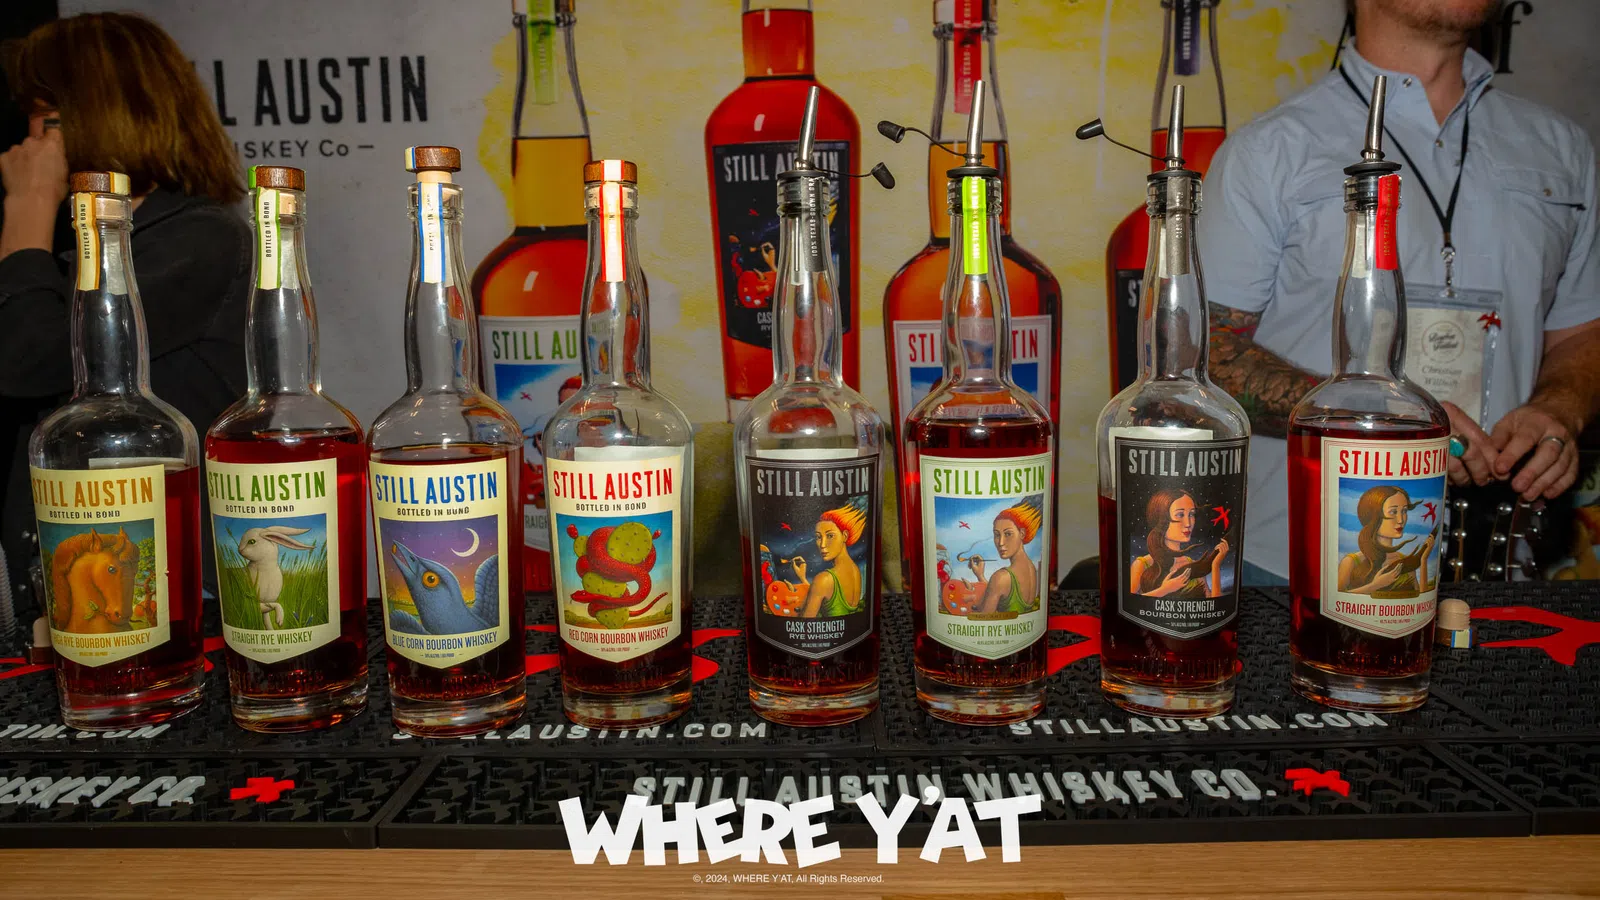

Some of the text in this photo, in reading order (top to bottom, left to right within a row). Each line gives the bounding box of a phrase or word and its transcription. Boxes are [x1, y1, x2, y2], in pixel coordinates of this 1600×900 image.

[254, 56, 428, 126] AUSTIN
[319, 139, 350, 157] Co
[724, 151, 839, 183] STILL AUTIN
[492, 330, 544, 360] STILL
[908, 333, 943, 362] STI
[1129, 449, 1241, 477] STILL AUSTIN
[1339, 448, 1447, 476] STILL AUSTIN
[208, 470, 326, 502] STILL AUSTIN
[376, 472, 498, 505] STILL AUSTIN
[554, 468, 673, 500] STILL AUSTIN
[757, 467, 869, 497] STILL AUSTIN
[934, 466, 1044, 496] STILL AUSTIN
[32, 477, 153, 508] STILL AUSTIN
[49, 510, 120, 519] BOTTLED IN BOND
[225, 504, 294, 514] BOTTLED IN BOND
[397, 507, 432, 516] BOTTLED
[434, 508, 443, 516] IN
[576, 502, 647, 512] BOTTLED IN BOND
[1139, 609, 1226, 620] BOURBON WHISKEY
[1155, 599, 1215, 612] CASK STRENGTH
[1336, 601, 1376, 616] STRAIGHT
[1379, 604, 1415, 616] BOURBON
[568, 626, 669, 644] RED CORN BOURBON WHISKEY
[786, 619, 845, 633] CASK STRENGTH
[947, 620, 1034, 636] STRAIGHT RYE WHISKEY
[64, 636, 75, 647] RYE
[76, 636, 111, 648] BOURBON
[114, 632, 151, 647] WHISKEY
[231, 630, 313, 646] STRAIGHT RYE WHISKEY
[392, 631, 498, 649] BLUE CORN BOURBON WHISKEY
[805, 631, 844, 640] WHISKEY
[1009, 712, 1389, 736] STILLAUSTIN.COM
[632, 768, 1277, 807] STILL AUSTIN WHISKEY CO.
